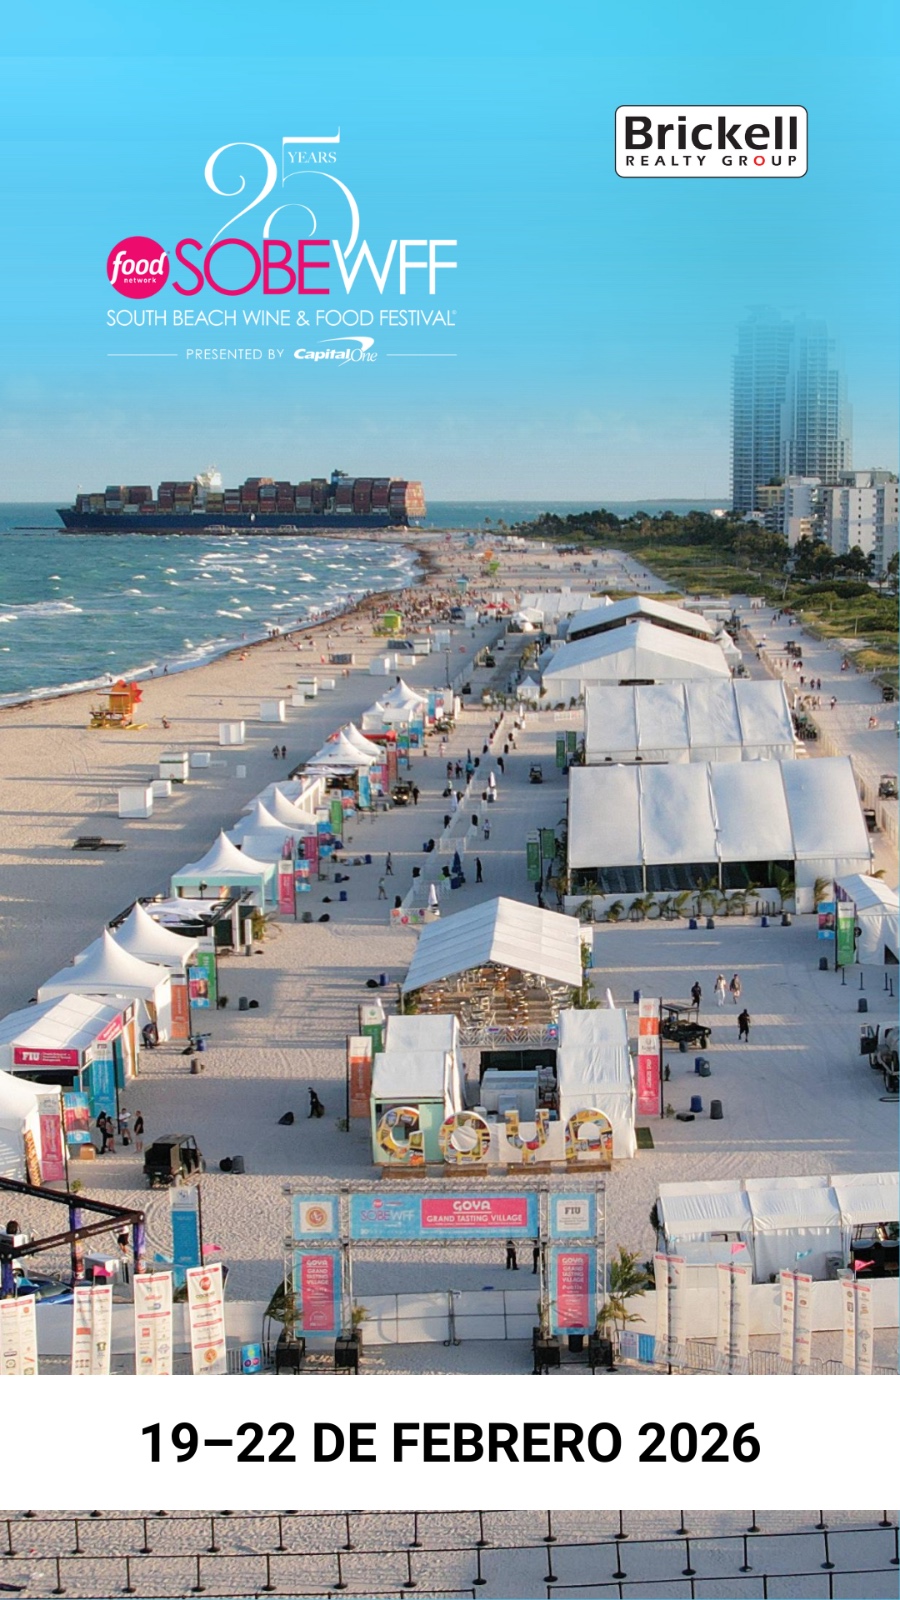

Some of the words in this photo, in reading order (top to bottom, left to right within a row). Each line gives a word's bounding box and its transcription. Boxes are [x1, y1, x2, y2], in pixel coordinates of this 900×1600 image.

[22, 1051, 40, 1061] FIU
[453, 1200, 491, 1212] GOYA
[564, 1206, 581, 1215] FIU
[427, 1215, 454, 1223] GRAND
[457, 1214, 489, 1222] TASTING
[491, 1214, 522, 1222] VILLAGE
